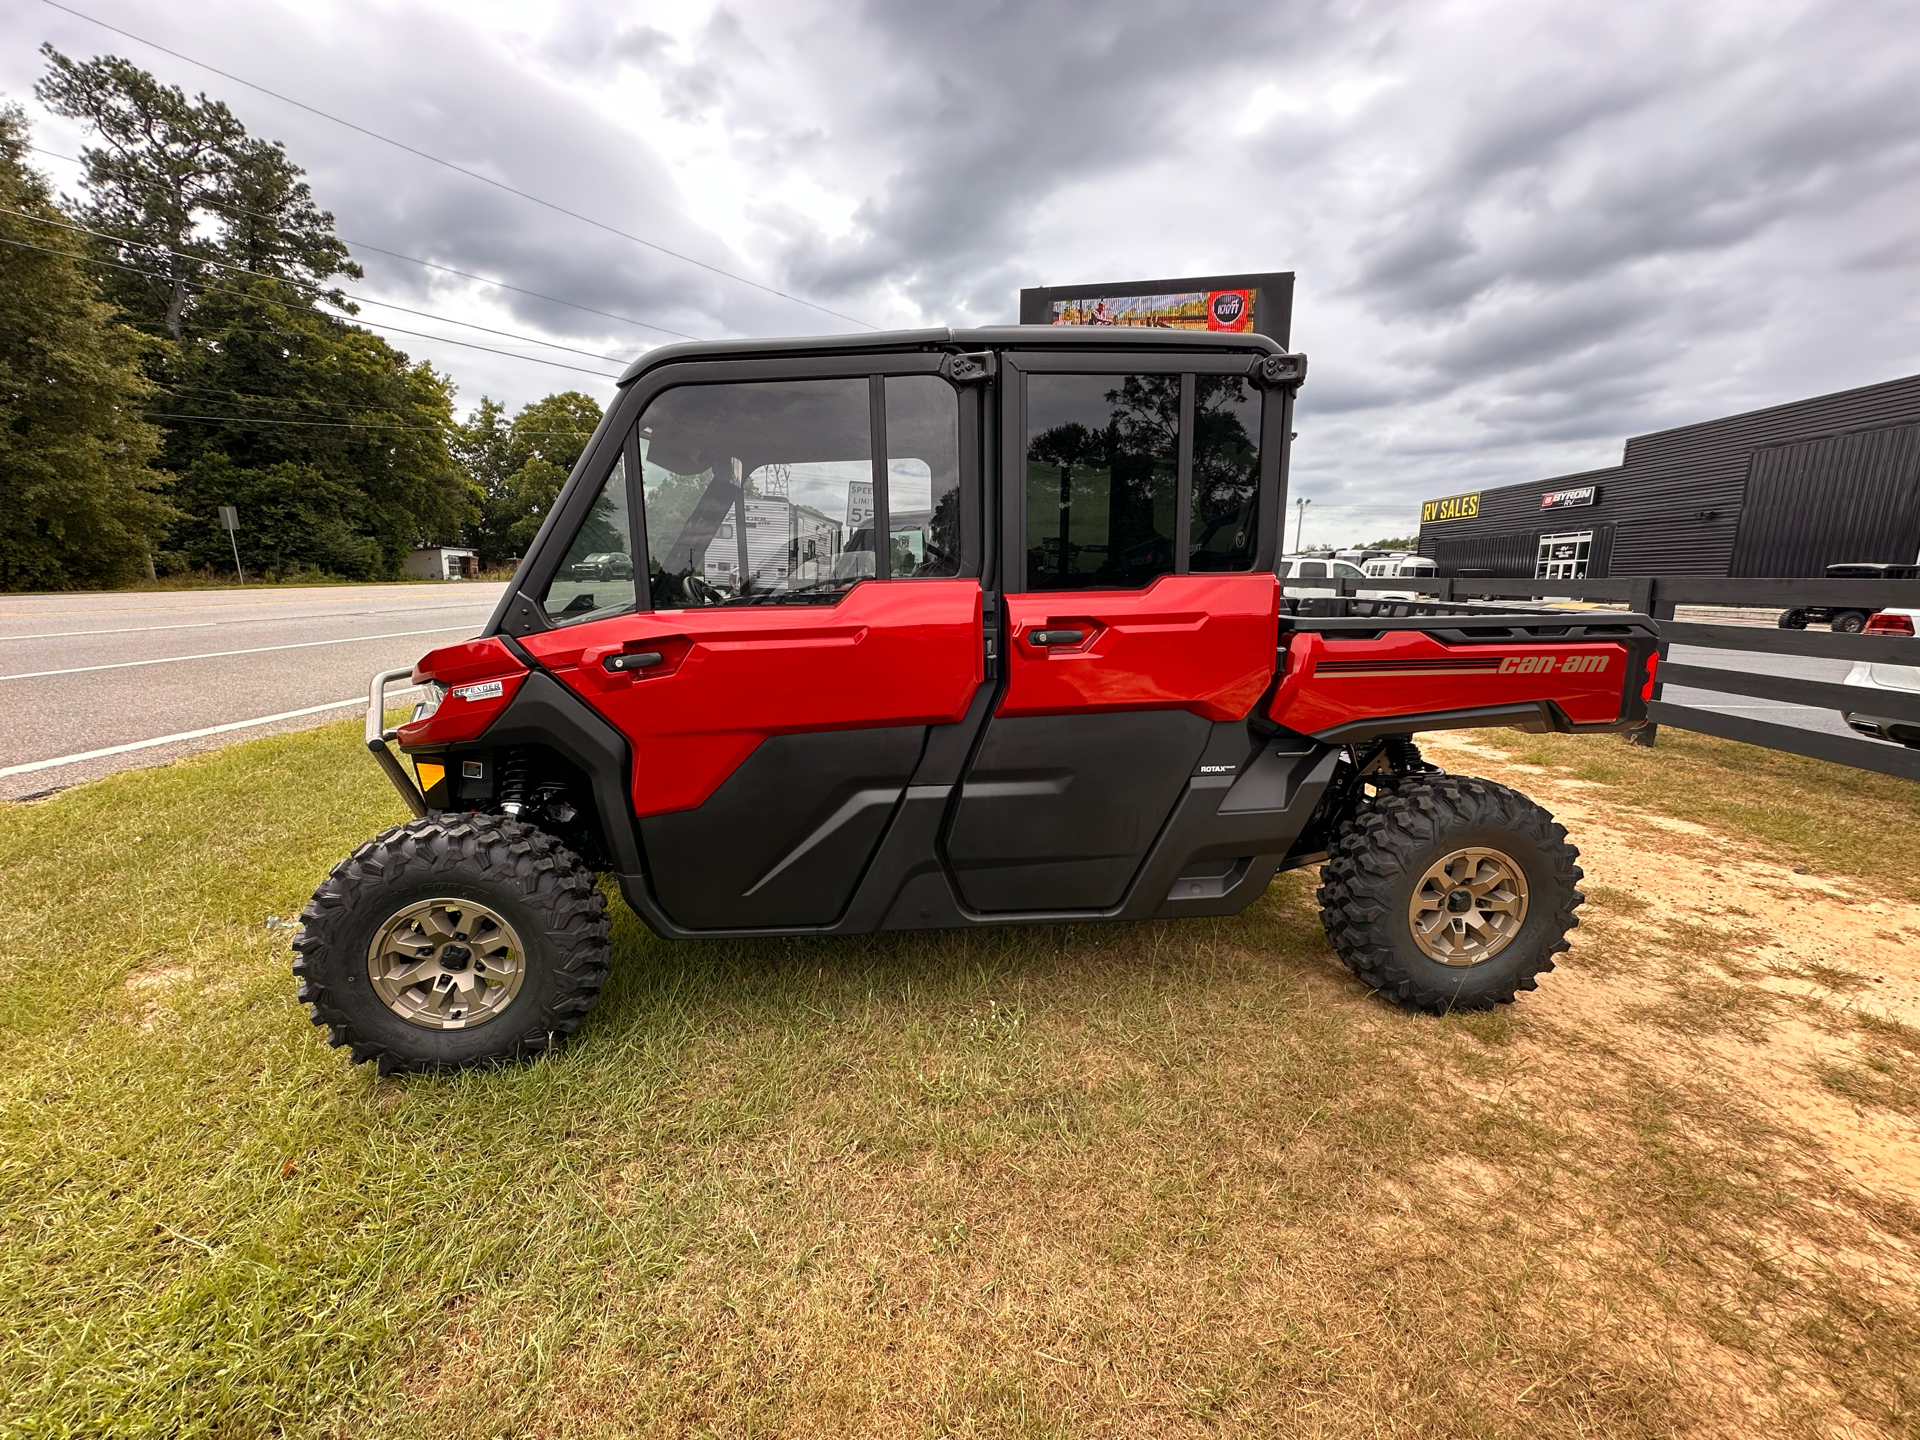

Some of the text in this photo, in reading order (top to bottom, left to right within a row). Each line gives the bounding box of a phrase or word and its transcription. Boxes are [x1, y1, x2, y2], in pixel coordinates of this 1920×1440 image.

[851, 486, 873, 495] SPEE
[1553, 489, 1591, 502] BYRON
[1423, 496, 1478, 521] RV SALES
[1563, 499, 1575, 507] RV
[1497, 655, 1610, 674] can-am
[454, 683, 501, 696] DEFENDER
[1200, 765, 1226, 773] ROTAX
